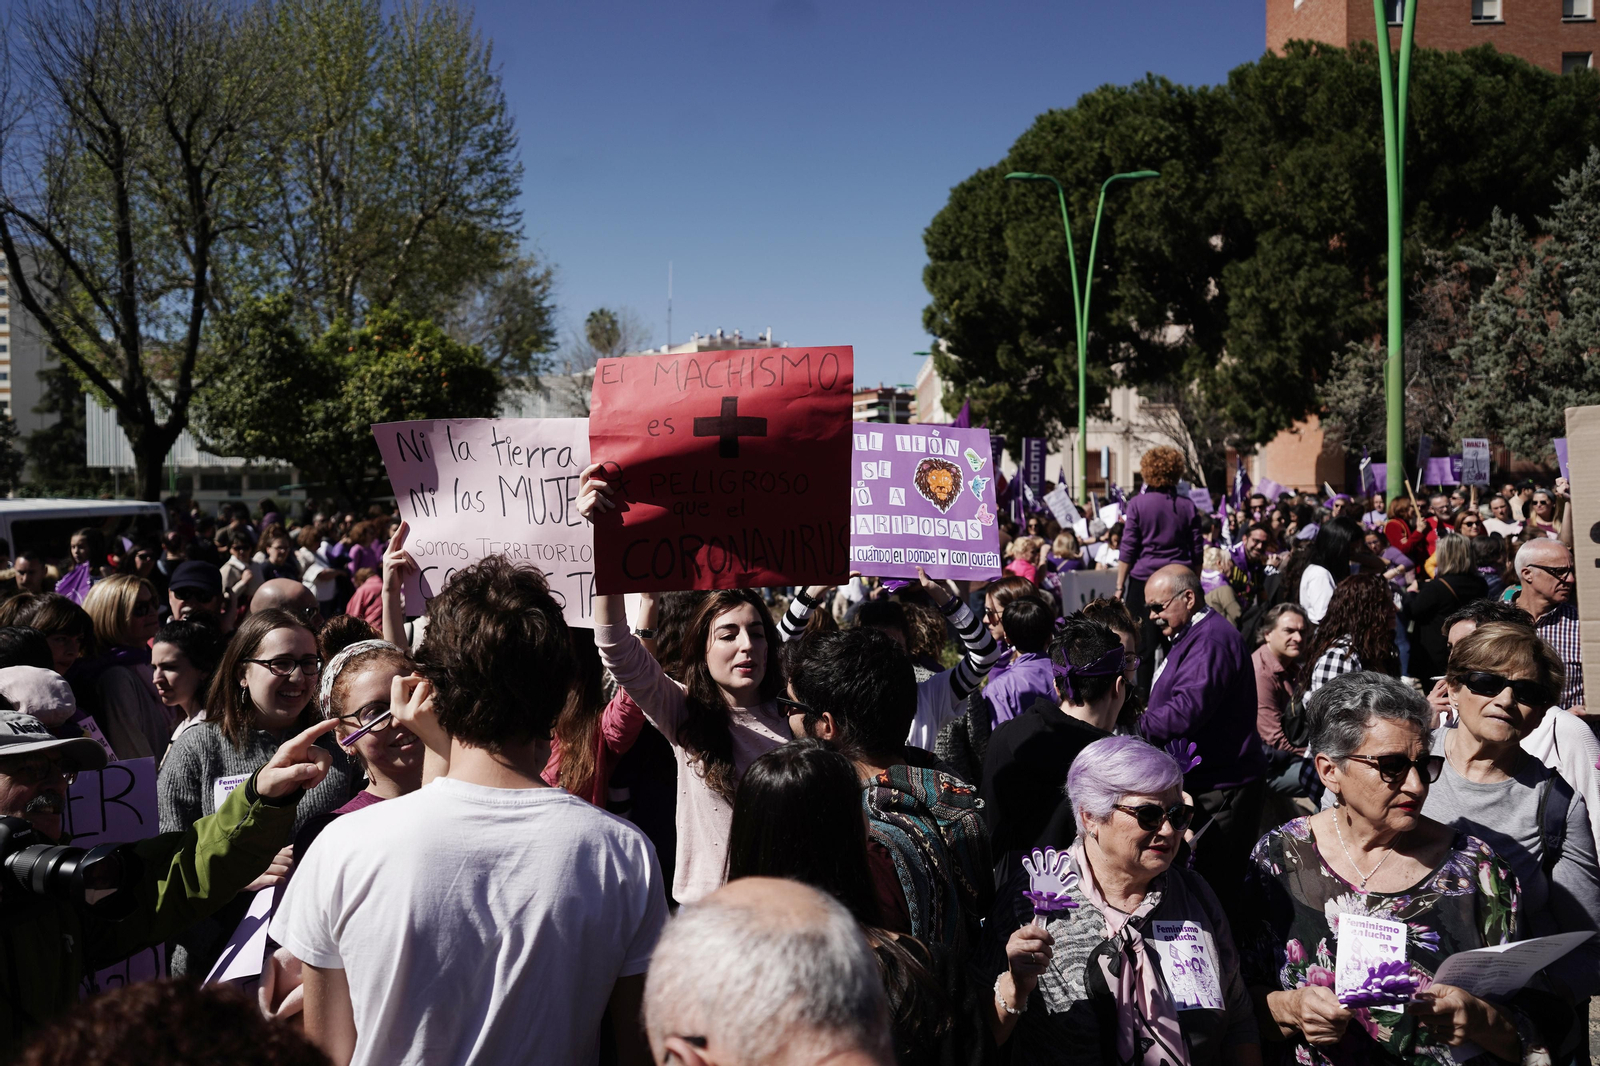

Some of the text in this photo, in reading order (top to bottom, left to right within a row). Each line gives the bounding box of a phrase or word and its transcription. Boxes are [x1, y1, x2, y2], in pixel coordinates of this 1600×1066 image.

[653, 351, 839, 392] MACHISMO
[647, 417, 675, 437] es
[396, 425, 578, 468] Ni la tierra
[864, 461, 889, 478] SE
[649, 469, 809, 498] PELIGROSO
[891, 488, 904, 505] A
[409, 474, 591, 529] Ni las MUJE
[672, 498, 745, 528] que el
[851, 515, 981, 539] ARIPOSAS
[621, 520, 849, 582] CORONAVIRUS
[61, 766, 143, 839] ER
[1156, 924, 1199, 934] Feminismo
[1175, 932, 1198, 942] lucha
[1364, 929, 1392, 941] lucha
